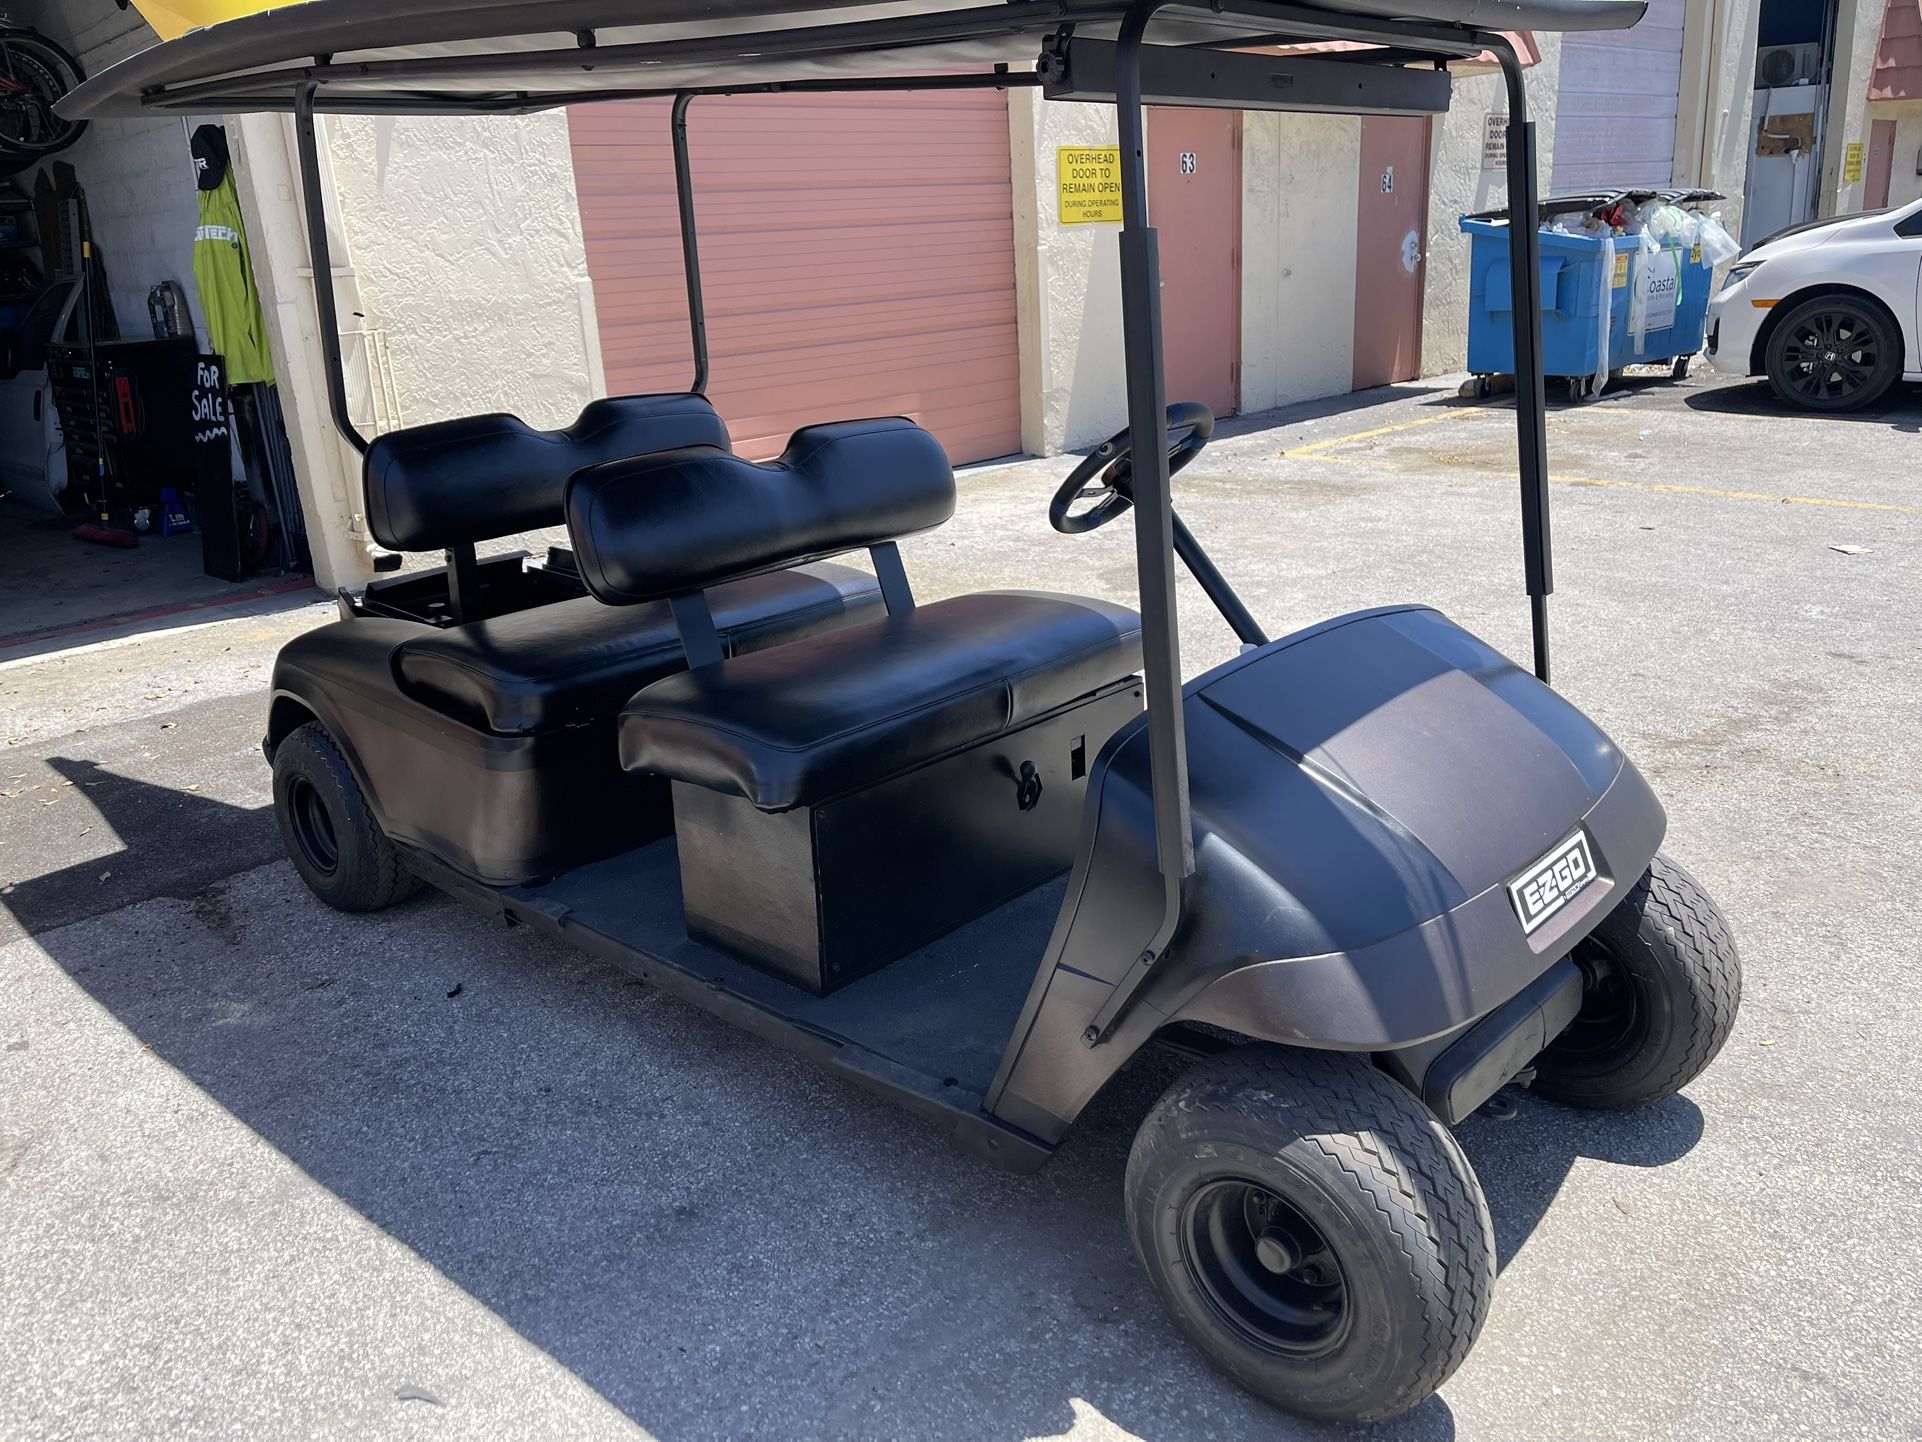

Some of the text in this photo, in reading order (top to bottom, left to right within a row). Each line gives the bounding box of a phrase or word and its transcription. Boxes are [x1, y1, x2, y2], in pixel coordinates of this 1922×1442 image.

[1487, 116, 1510, 127] OVERH
[1067, 153, 1115, 164] OVERHEAD
[1182, 153, 1195, 173] 63
[1072, 167, 1111, 178] DOOR TO
[1062, 182, 1120, 193] REMAIN OPEN
[1381, 174, 1392, 192] 64
[1064, 199, 1120, 208] DURING OPERATING
[1083, 209, 1103, 218] HOURS
[197, 361, 220, 389] FOR
[192, 389, 225, 421] SALE
